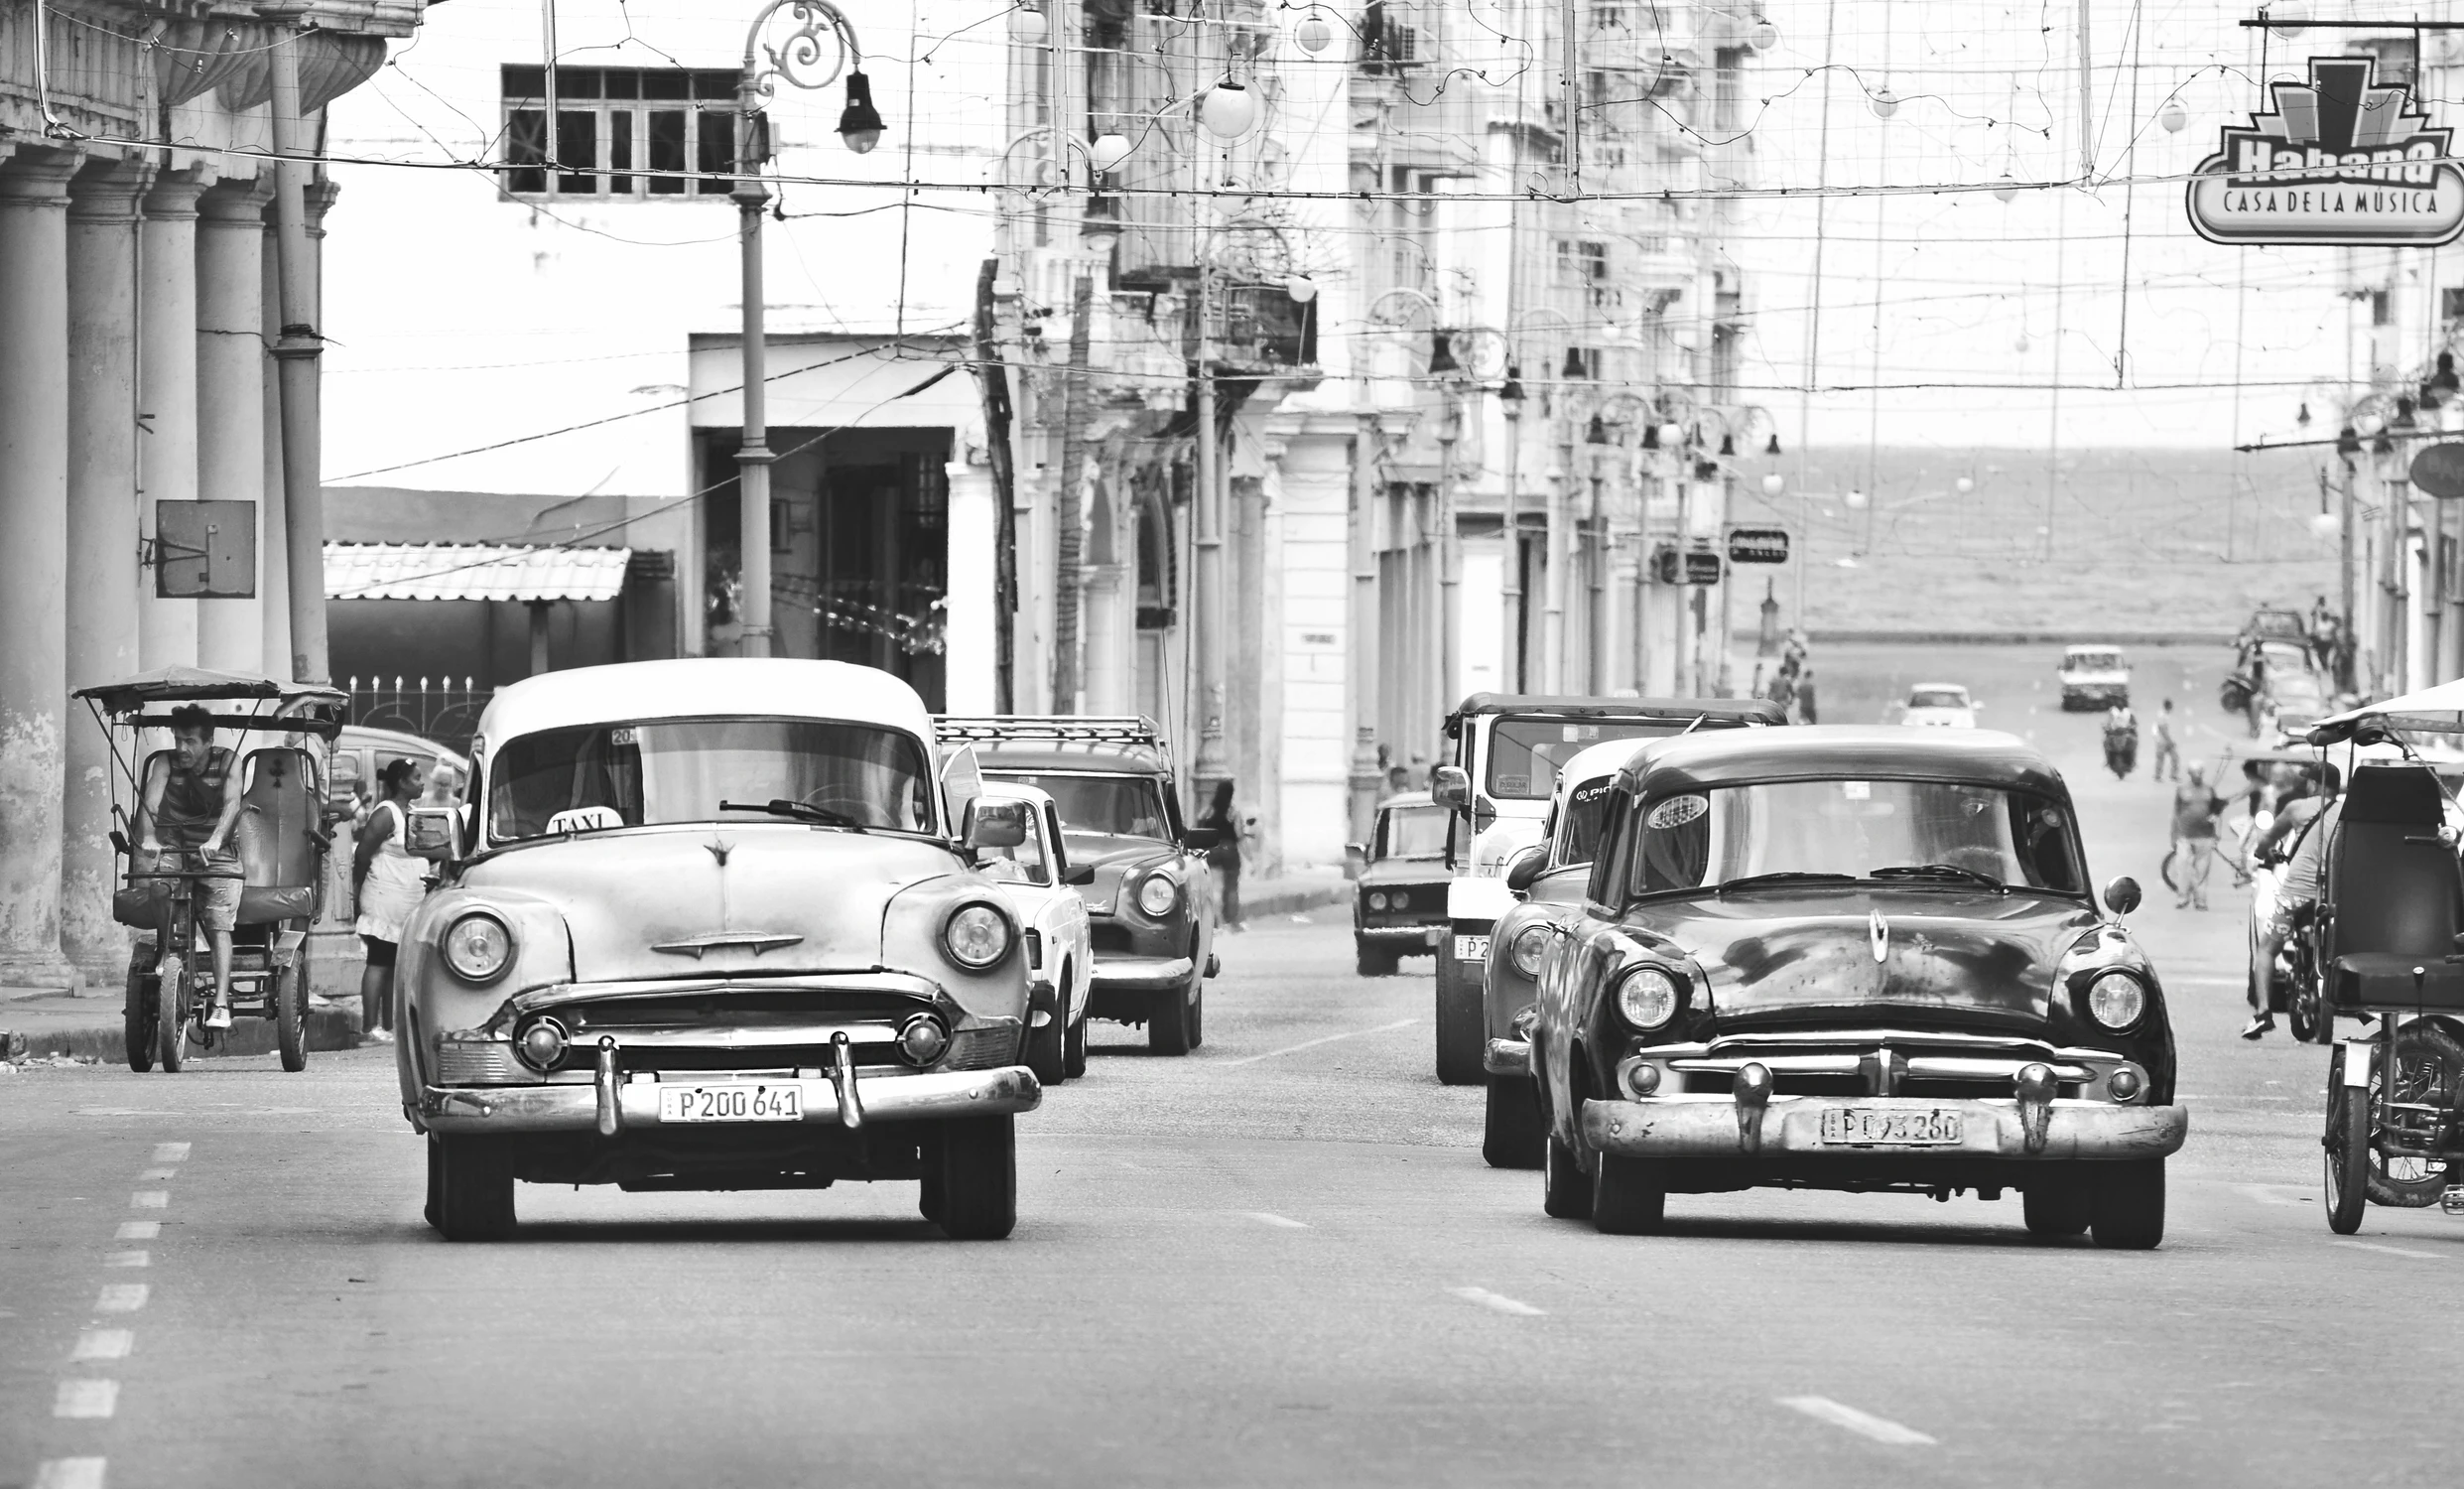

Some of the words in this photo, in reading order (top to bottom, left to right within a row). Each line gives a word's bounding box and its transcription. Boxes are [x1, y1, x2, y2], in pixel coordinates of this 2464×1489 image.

[2238, 139, 2436, 184] Habana
[2224, 191, 2277, 212] CASA
[2287, 191, 2310, 212] DE
[2321, 191, 2344, 212] LA
[553, 813, 601, 833] TAXI
[1468, 941, 1477, 957] P
